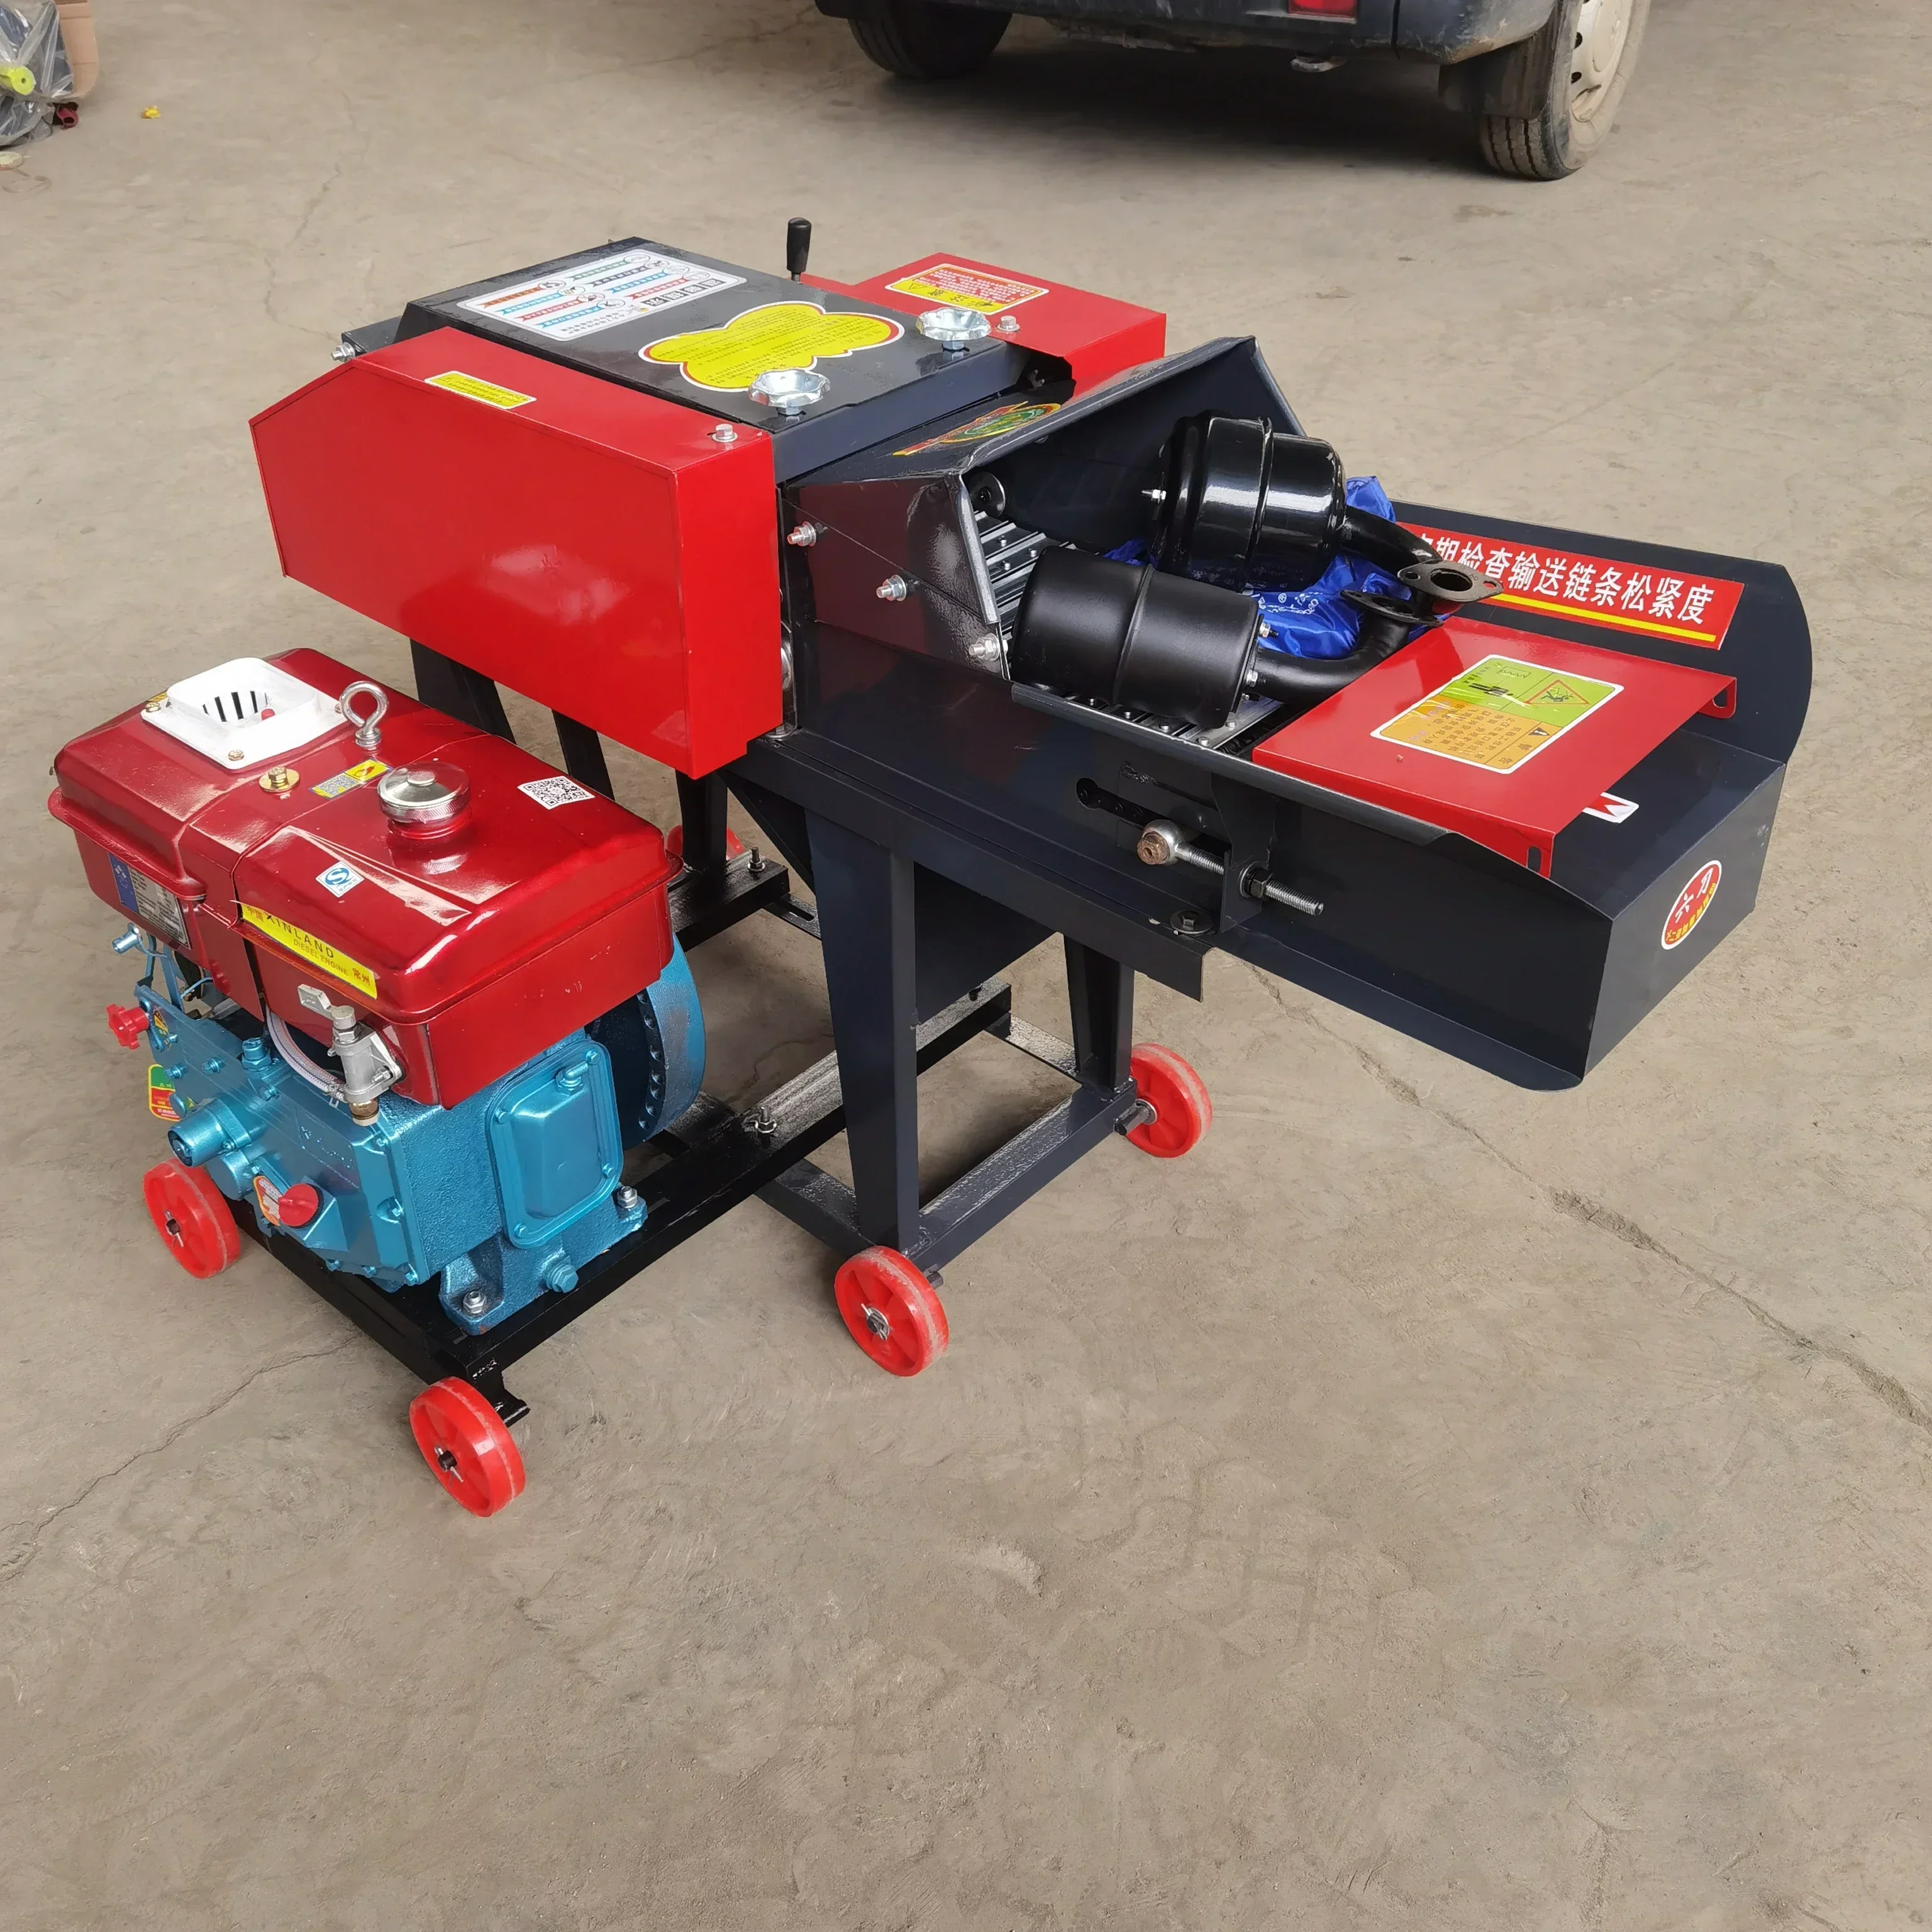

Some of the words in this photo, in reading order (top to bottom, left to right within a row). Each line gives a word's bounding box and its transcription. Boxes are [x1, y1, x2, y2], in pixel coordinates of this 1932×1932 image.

[265, 914, 335, 958] XINLAND
[293, 938, 319, 959] DIESEL
[319, 955, 349, 976] ENGINE
